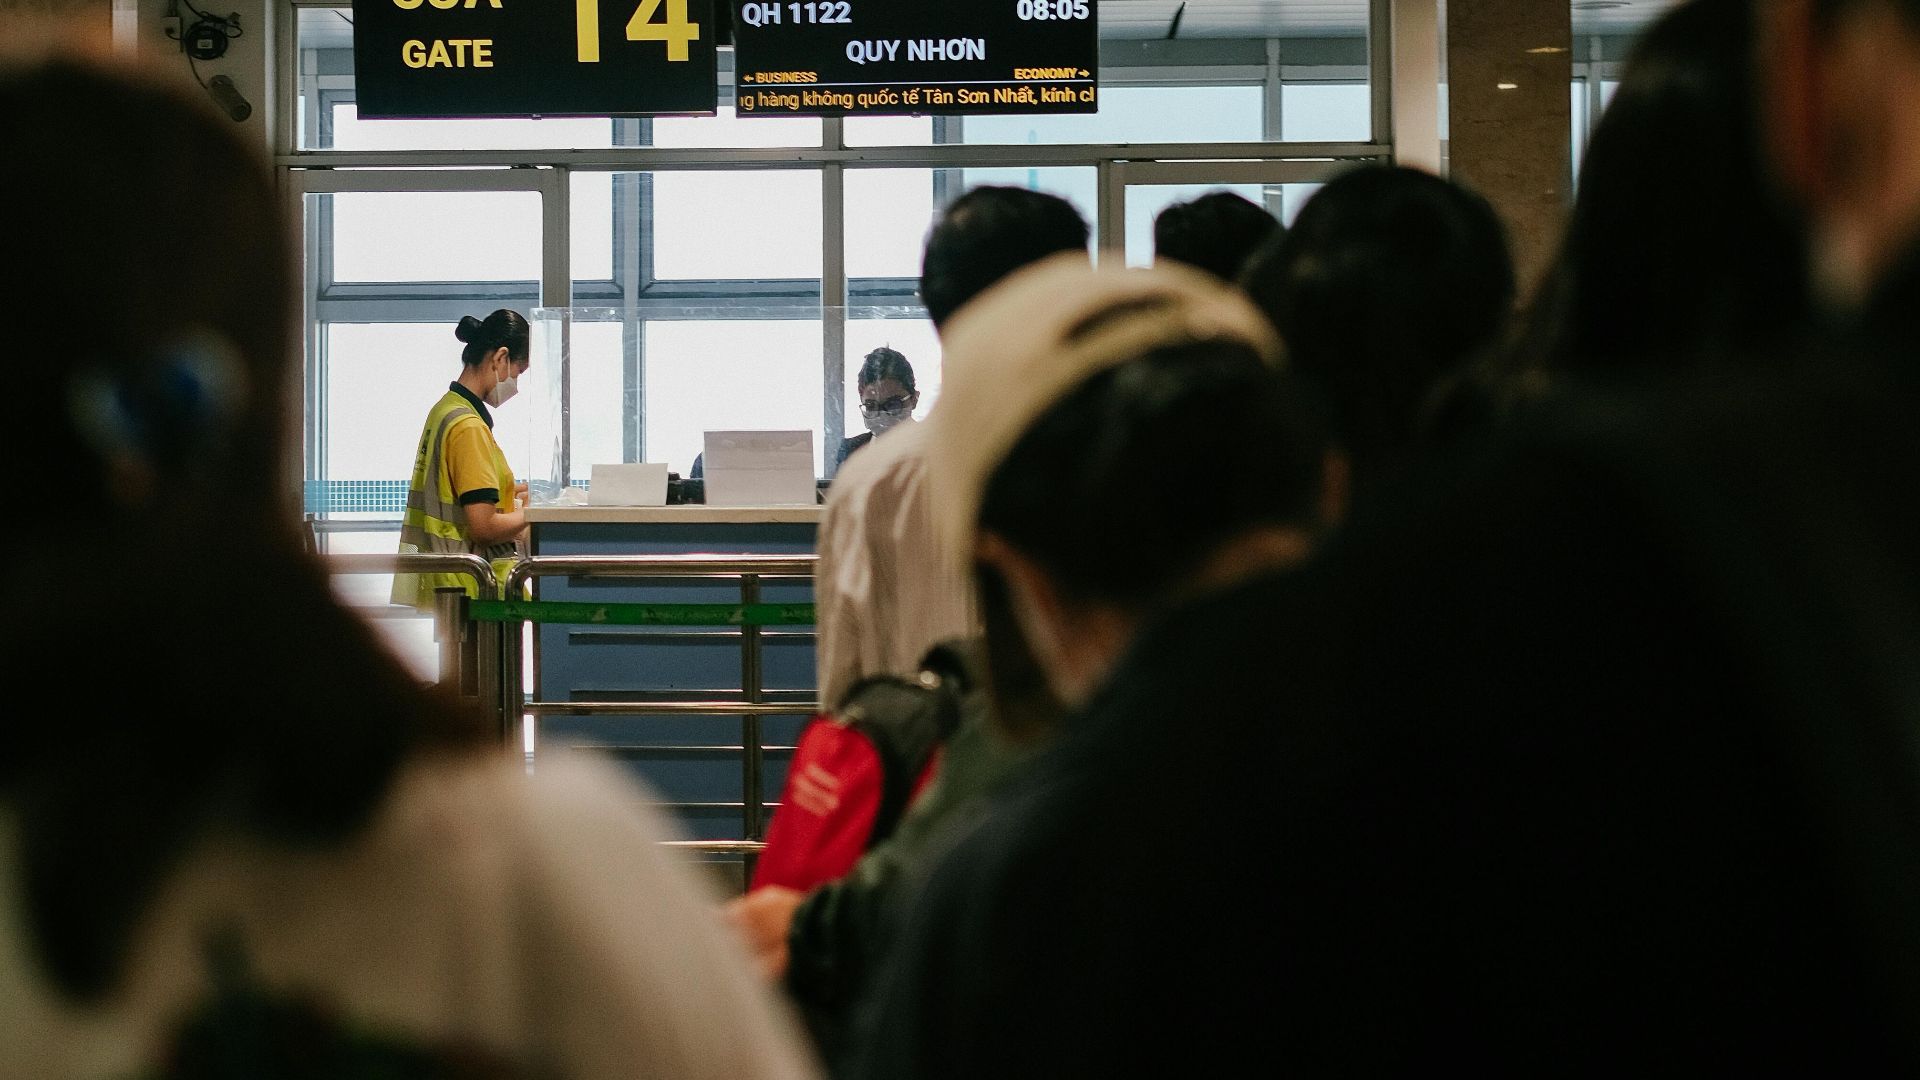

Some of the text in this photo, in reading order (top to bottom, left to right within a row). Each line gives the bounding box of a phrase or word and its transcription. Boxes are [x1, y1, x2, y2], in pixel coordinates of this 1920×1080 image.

[742, 1, 851, 27] QH 1122
[1017, 0, 1089, 20] 08:05
[576, 0, 699, 62] 14
[402, 40, 493, 68] GATE
[846, 37, 985, 65] QUY NHƠN
[756, 71, 817, 83] BUSINESS
[1014, 68, 1077, 80] ECONOMY
[759, 91, 799, 110] hàng
[803, 90, 854, 109] không
[857, 88, 898, 109] quốc
[902, 87, 920, 104] tế
[922, 88, 953, 104] Tân
[957, 89, 990, 104] Sơn
[993, 86, 1038, 105] Nhất,
[1041, 87, 1076, 103] kính
